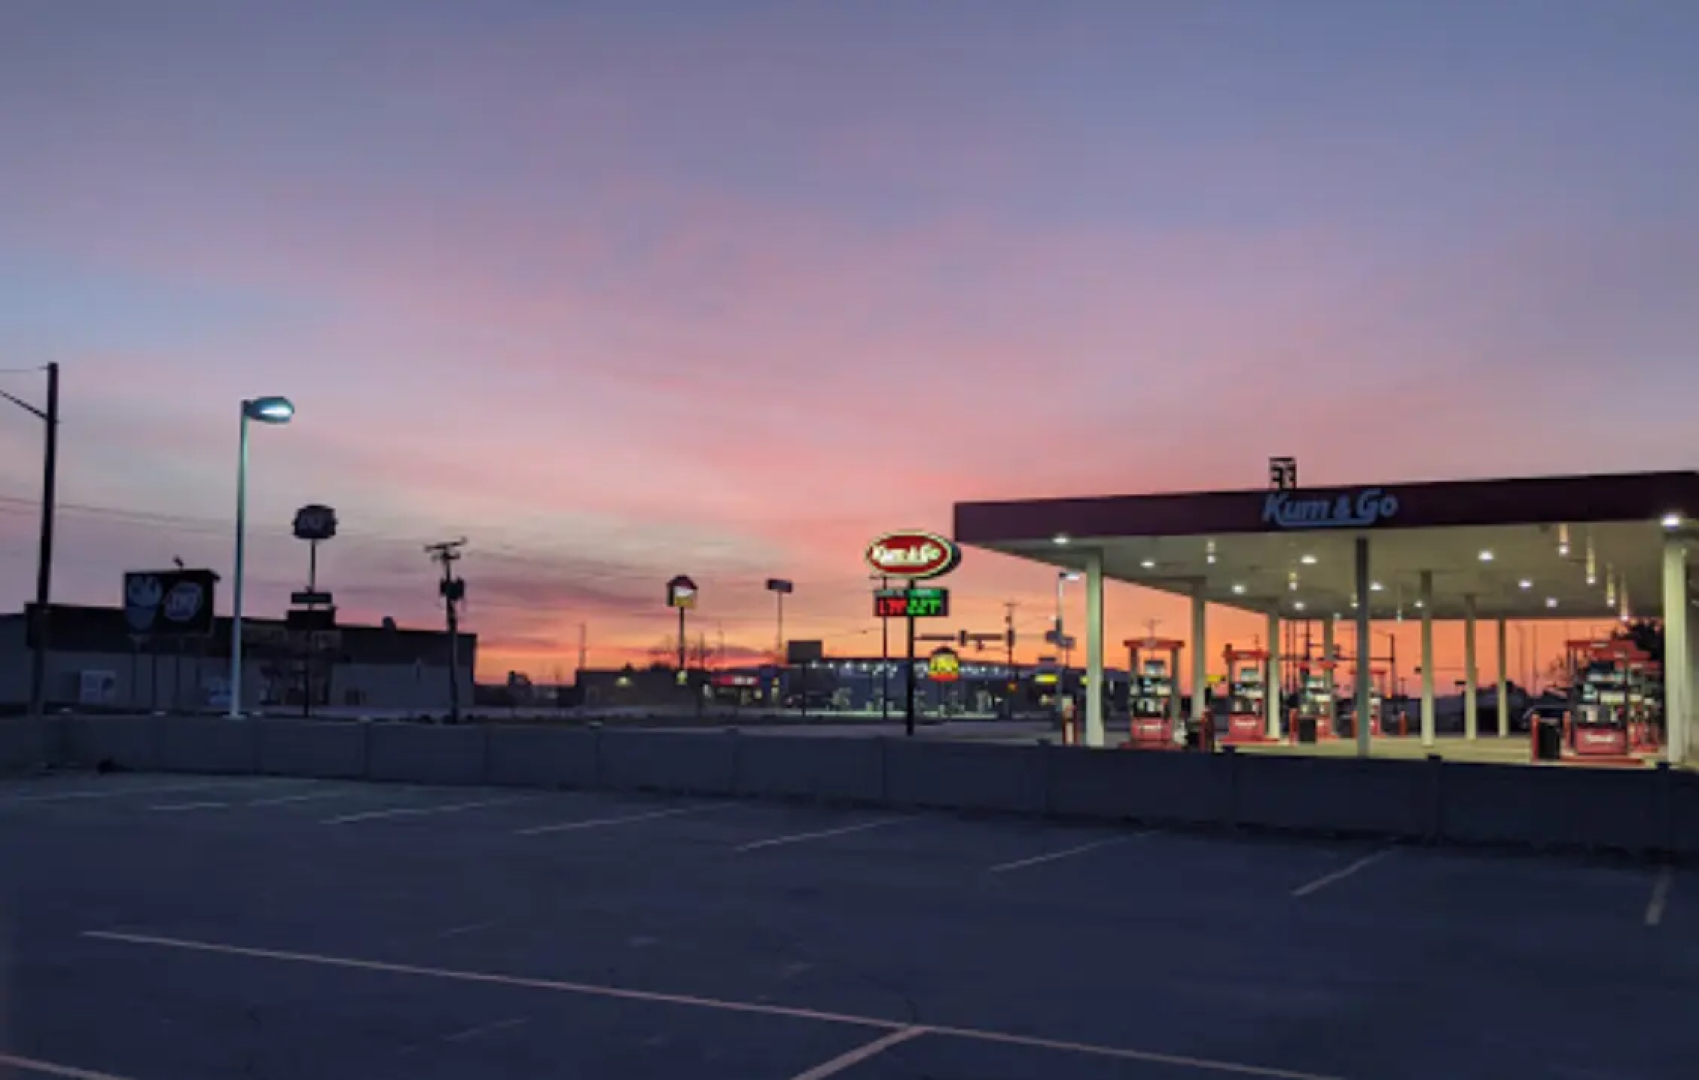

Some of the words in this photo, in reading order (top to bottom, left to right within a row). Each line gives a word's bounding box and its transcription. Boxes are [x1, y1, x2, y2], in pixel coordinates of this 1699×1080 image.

[1262, 492, 1330, 523] Kum
[1333, 494, 1351, 521] &
[1357, 488, 1398, 525] Go
